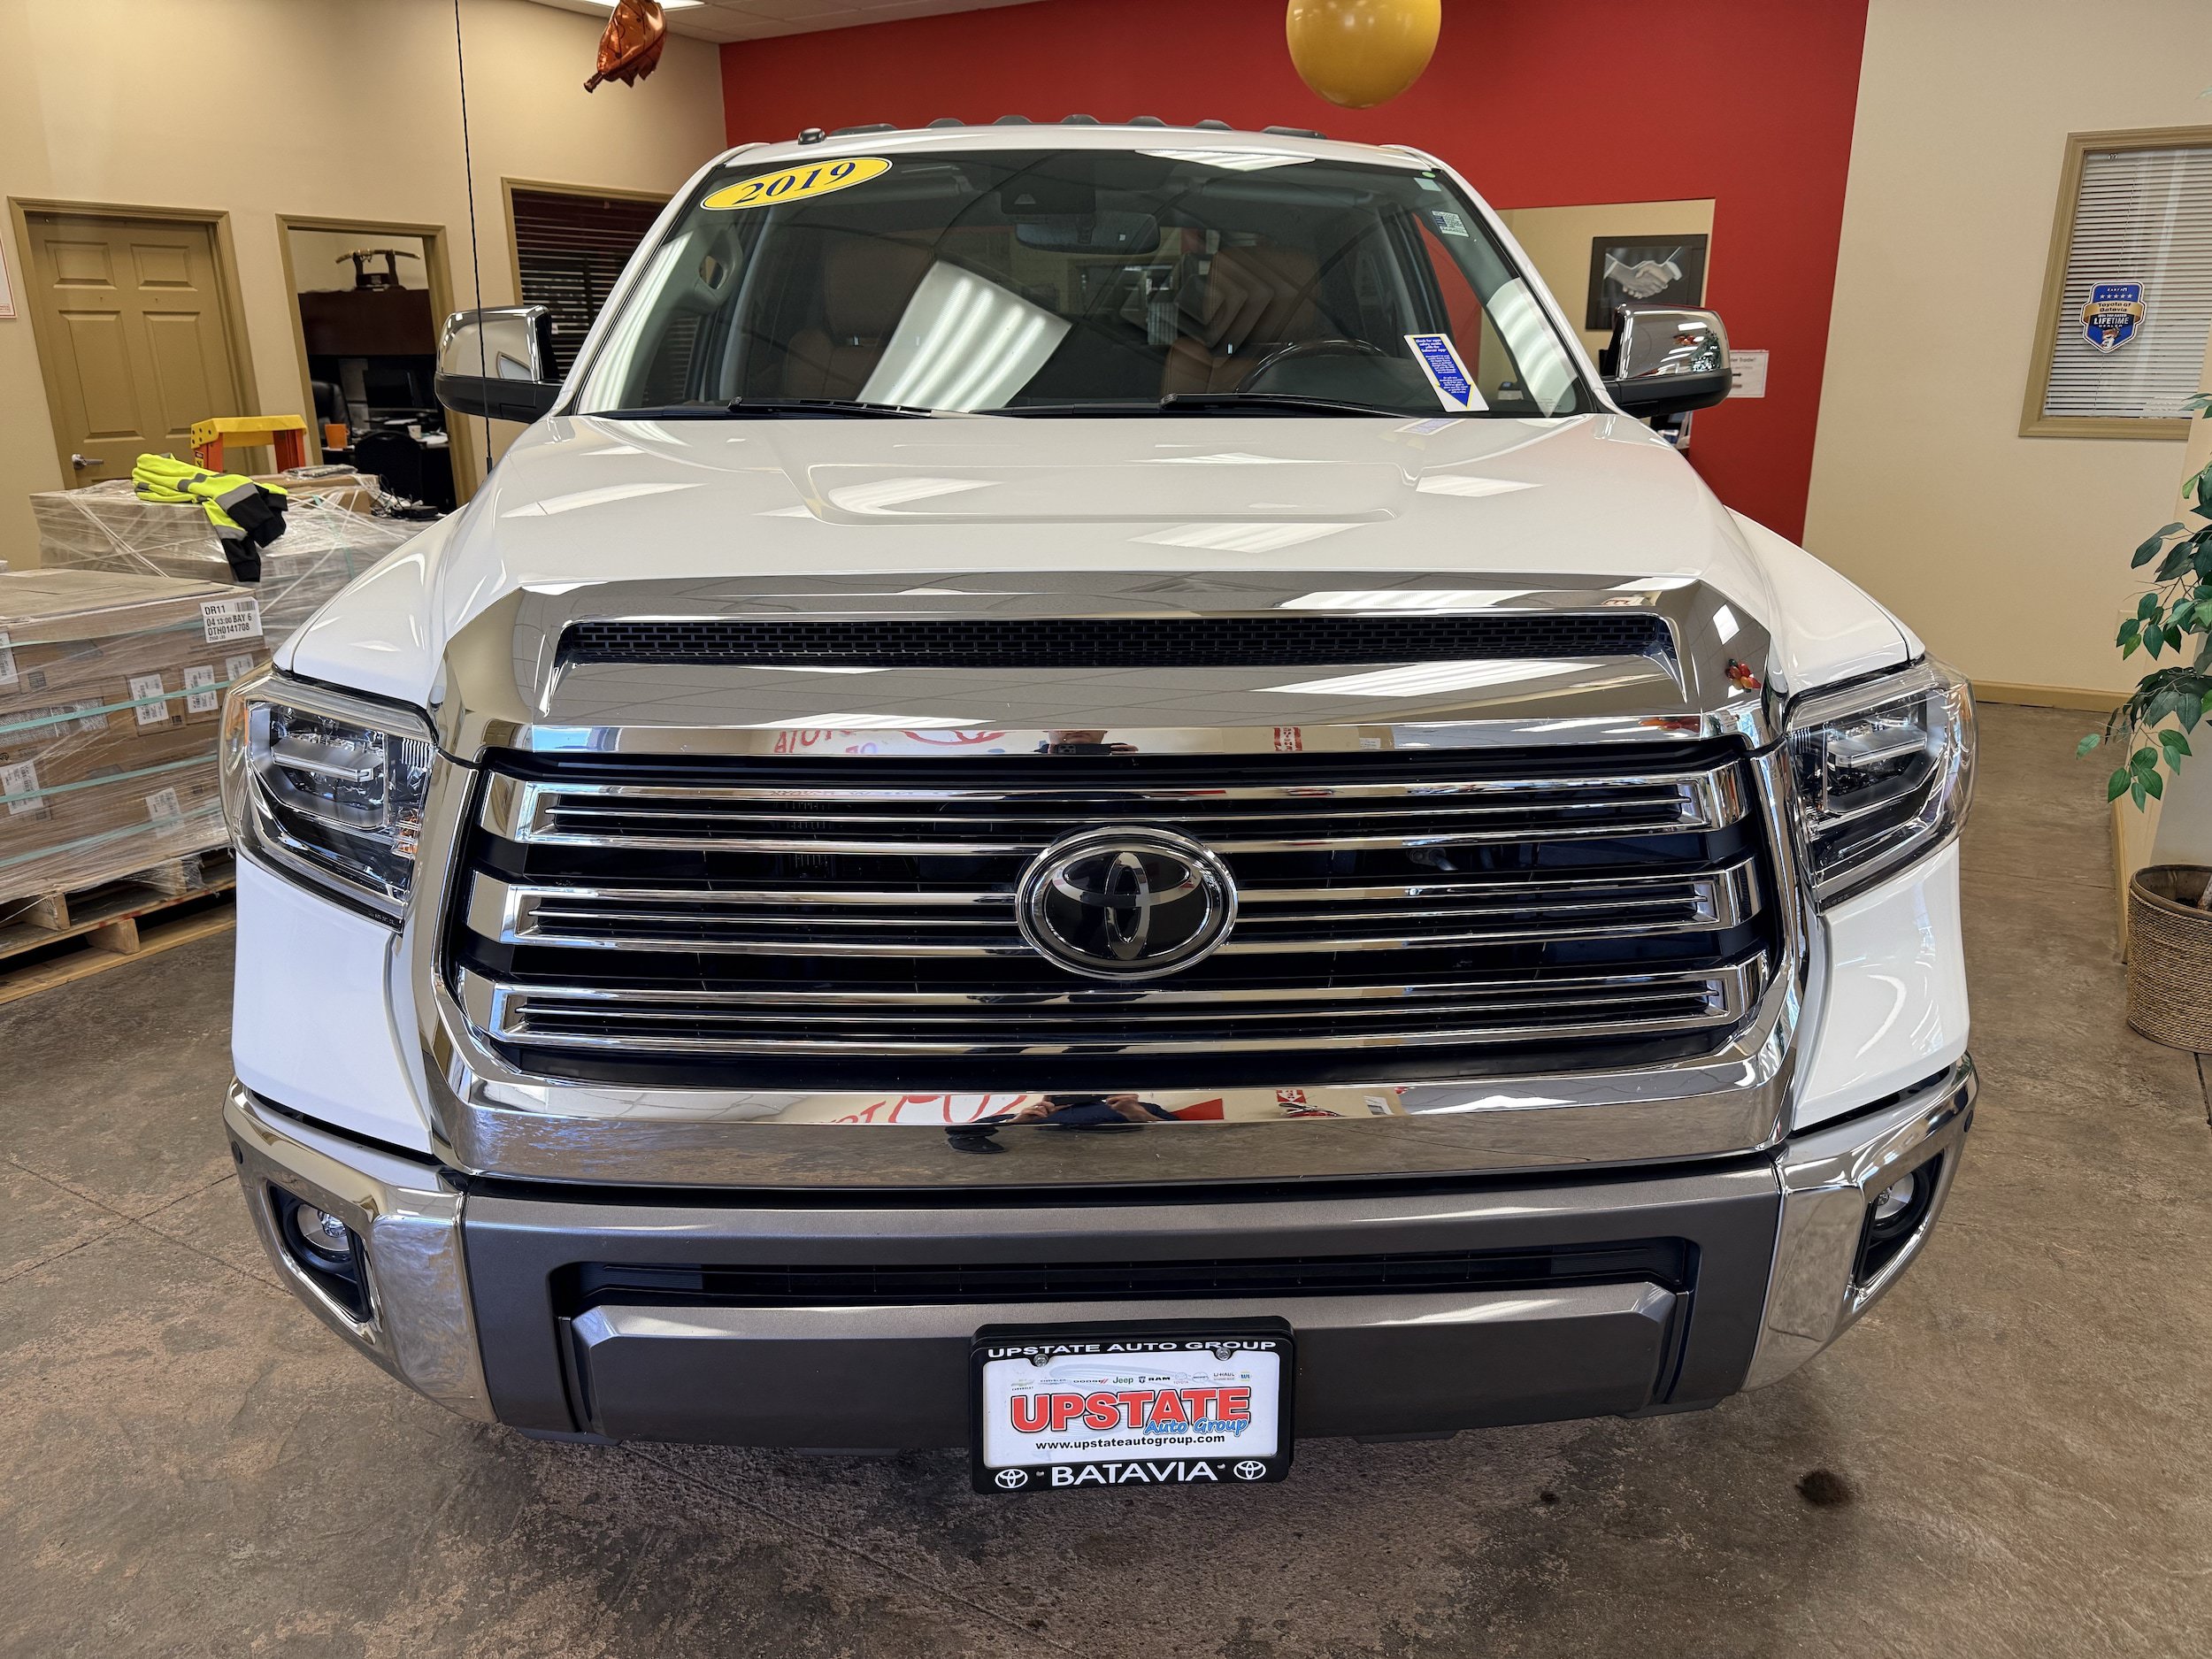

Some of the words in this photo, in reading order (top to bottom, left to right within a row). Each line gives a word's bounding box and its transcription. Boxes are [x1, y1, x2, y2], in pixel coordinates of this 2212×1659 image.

[732, 162, 856, 205] 2019
[204, 605, 226, 615] DR11
[207, 618, 215, 626] 04
[233, 614, 245, 623] BAY
[988, 1344, 1100, 1357] UPSTATE
[1106, 1342, 1178, 1352] AUTO
[1186, 1340, 1277, 1350] GROUP
[1112, 1376, 1133, 1385] Jeep
[1010, 1386, 1252, 1433] UPSTATE
[1143, 1418, 1188, 1436] Auto
[1194, 1417, 1248, 1437] Group
[1035, 1434, 1225, 1450] www.upstateautogroup.com
[1051, 1460, 1217, 1487] BATAVIA
